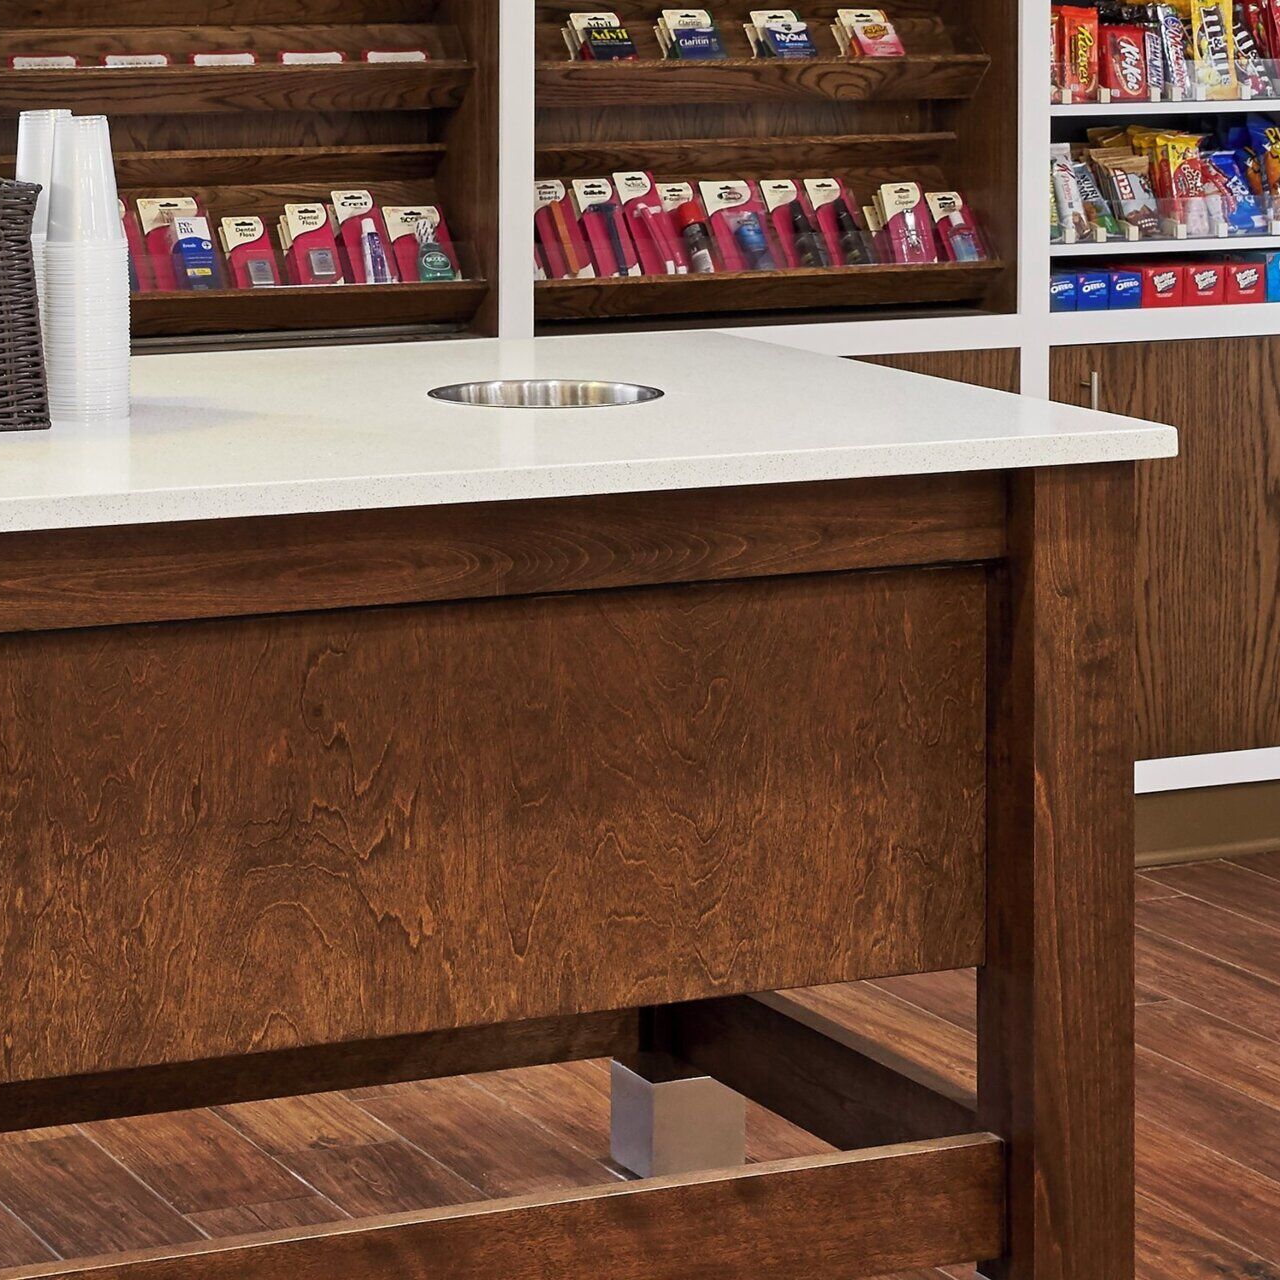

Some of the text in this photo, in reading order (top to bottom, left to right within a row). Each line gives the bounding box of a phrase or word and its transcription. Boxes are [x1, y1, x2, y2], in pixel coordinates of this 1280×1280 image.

[591, 28, 628, 39] Advil
[775, 33, 808, 42] NyQuil
[680, 37, 709, 47] Claritin
[1077, 179, 1091, 201] RAIN
